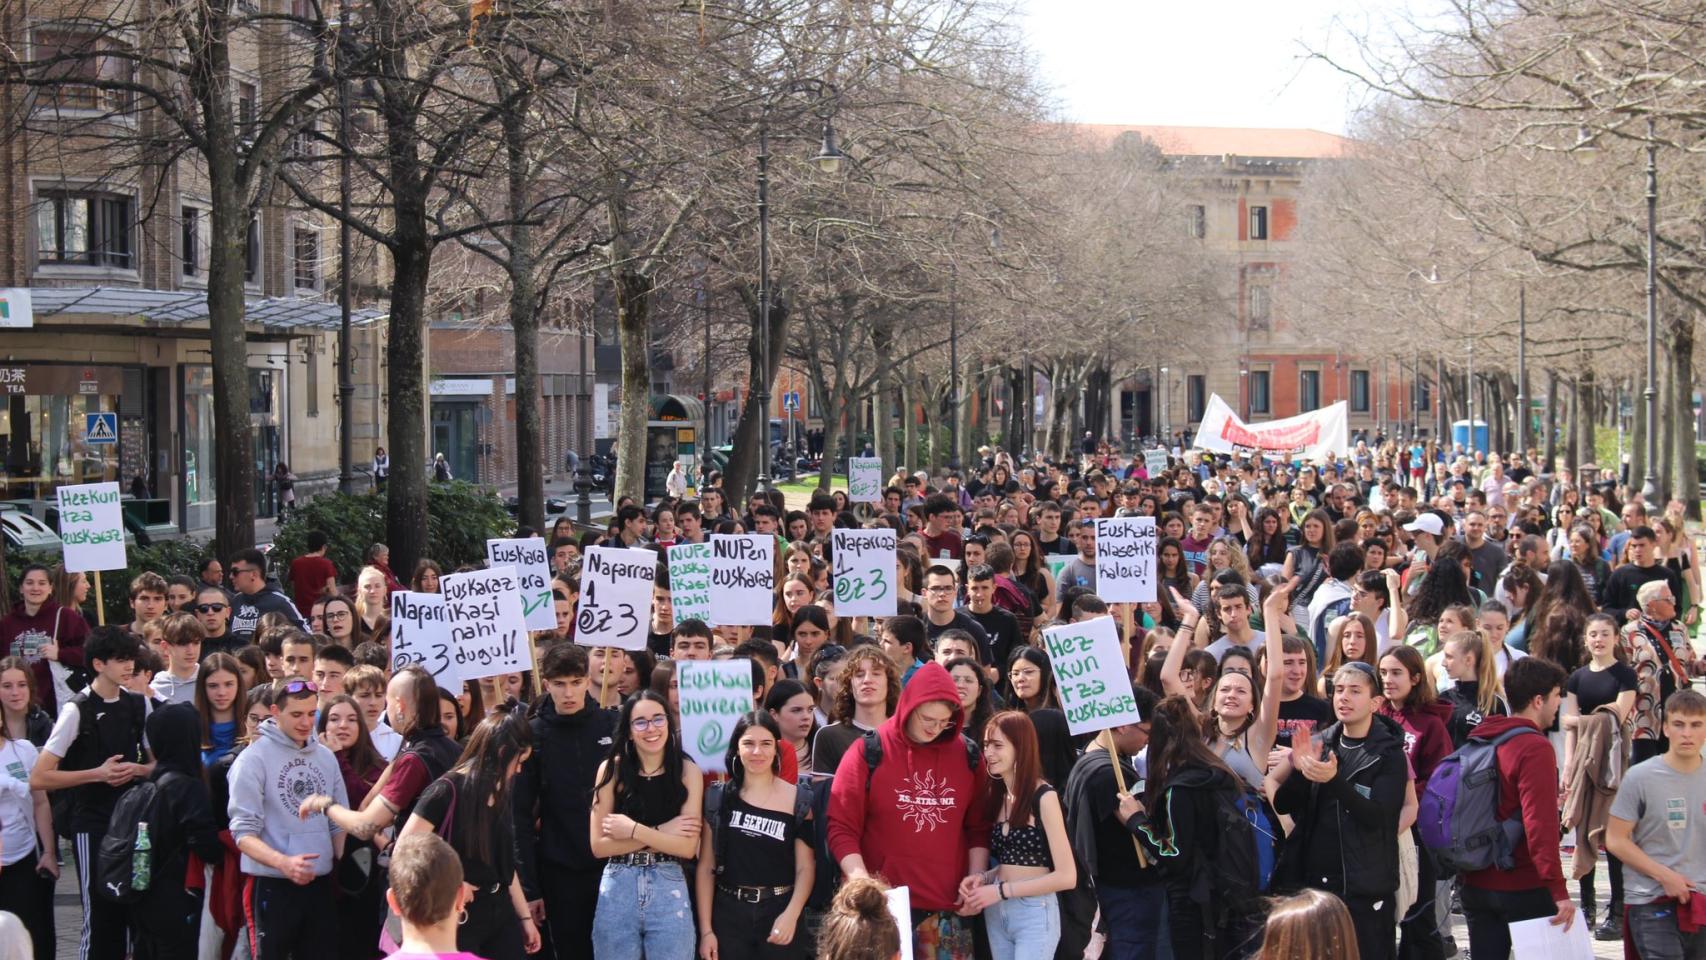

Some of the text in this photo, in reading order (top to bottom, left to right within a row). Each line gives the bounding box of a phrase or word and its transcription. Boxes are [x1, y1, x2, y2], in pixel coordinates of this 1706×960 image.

[6, 385, 26, 393] TEA
[670, 544, 711, 561] NUPe
[834, 532, 896, 557] Nafarroa
[588, 553, 655, 584] Nafarroa
[670, 563, 709, 577] euska
[834, 553, 853, 577] 1
[583, 580, 598, 607] 1
[869, 569, 887, 600] 3
[394, 593, 446, 629] Nafarr
[616, 604, 638, 637] 3
[394, 624, 412, 649] 1
[452, 622, 496, 643] nahi
[1046, 633, 1094, 658] Hez
[432, 644, 450, 676] 3
[277, 758, 307, 788] BRIGADE
[742, 813, 786, 841] SERVIUM
